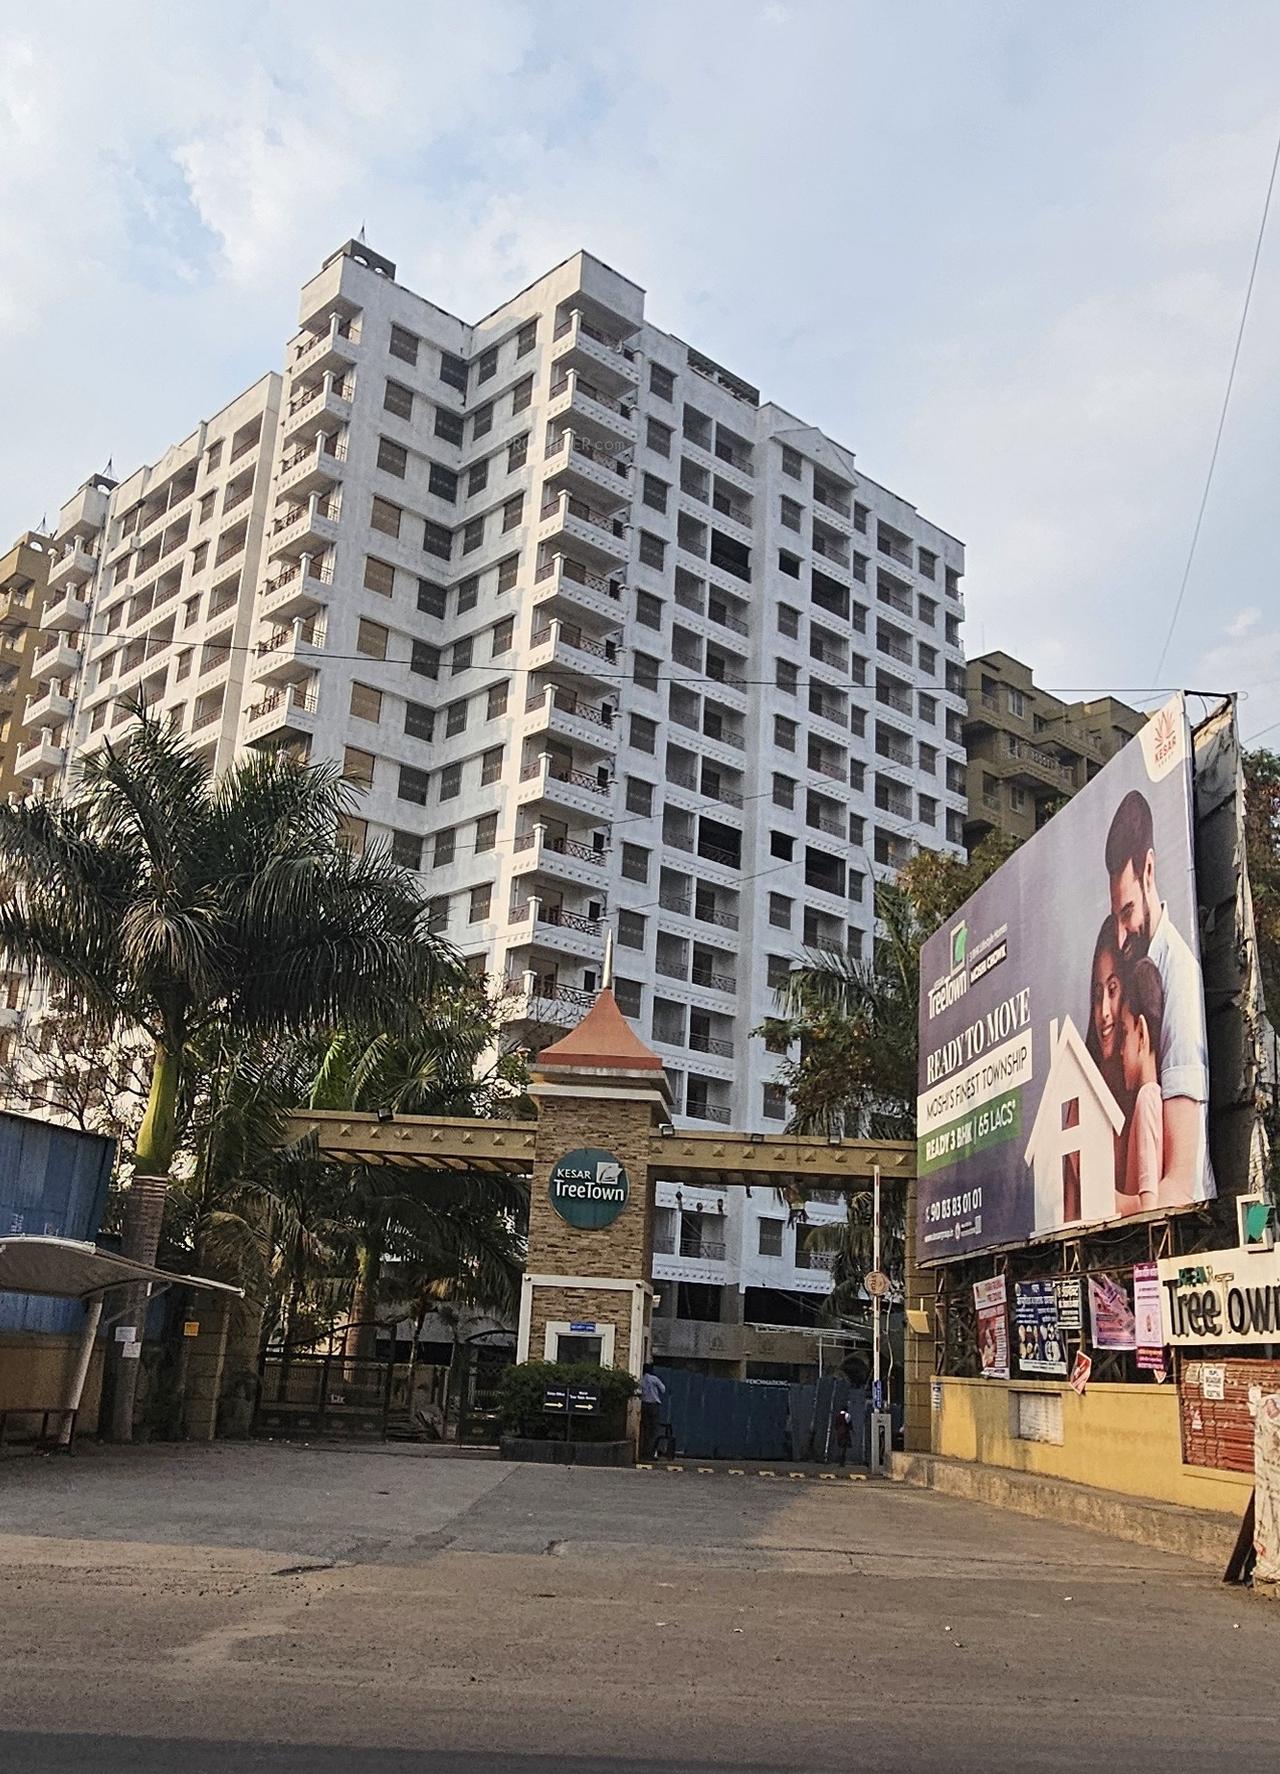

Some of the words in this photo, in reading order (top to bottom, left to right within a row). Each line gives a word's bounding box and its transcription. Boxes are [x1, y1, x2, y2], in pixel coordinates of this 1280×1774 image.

[928, 970, 967, 1020] TreeTown
[927, 1033, 963, 1085] READY
[965, 1019, 985, 1060] TO
[987, 986, 1031, 1047] MOVE
[955, 1071, 981, 1105] FINEST
[982, 1046, 1028, 1089] TOWNSHIP
[925, 1131, 950, 1162] READY
[949, 1130, 956, 1151] 3
[978, 1112, 989, 1137] 65
[553, 1178, 625, 1202] TreeTown
[557, 1168, 592, 1180] KESAR
[930, 1202, 941, 1222] 90
[962, 1192, 971, 1214] 01
[972, 1186, 982, 1210] 01
